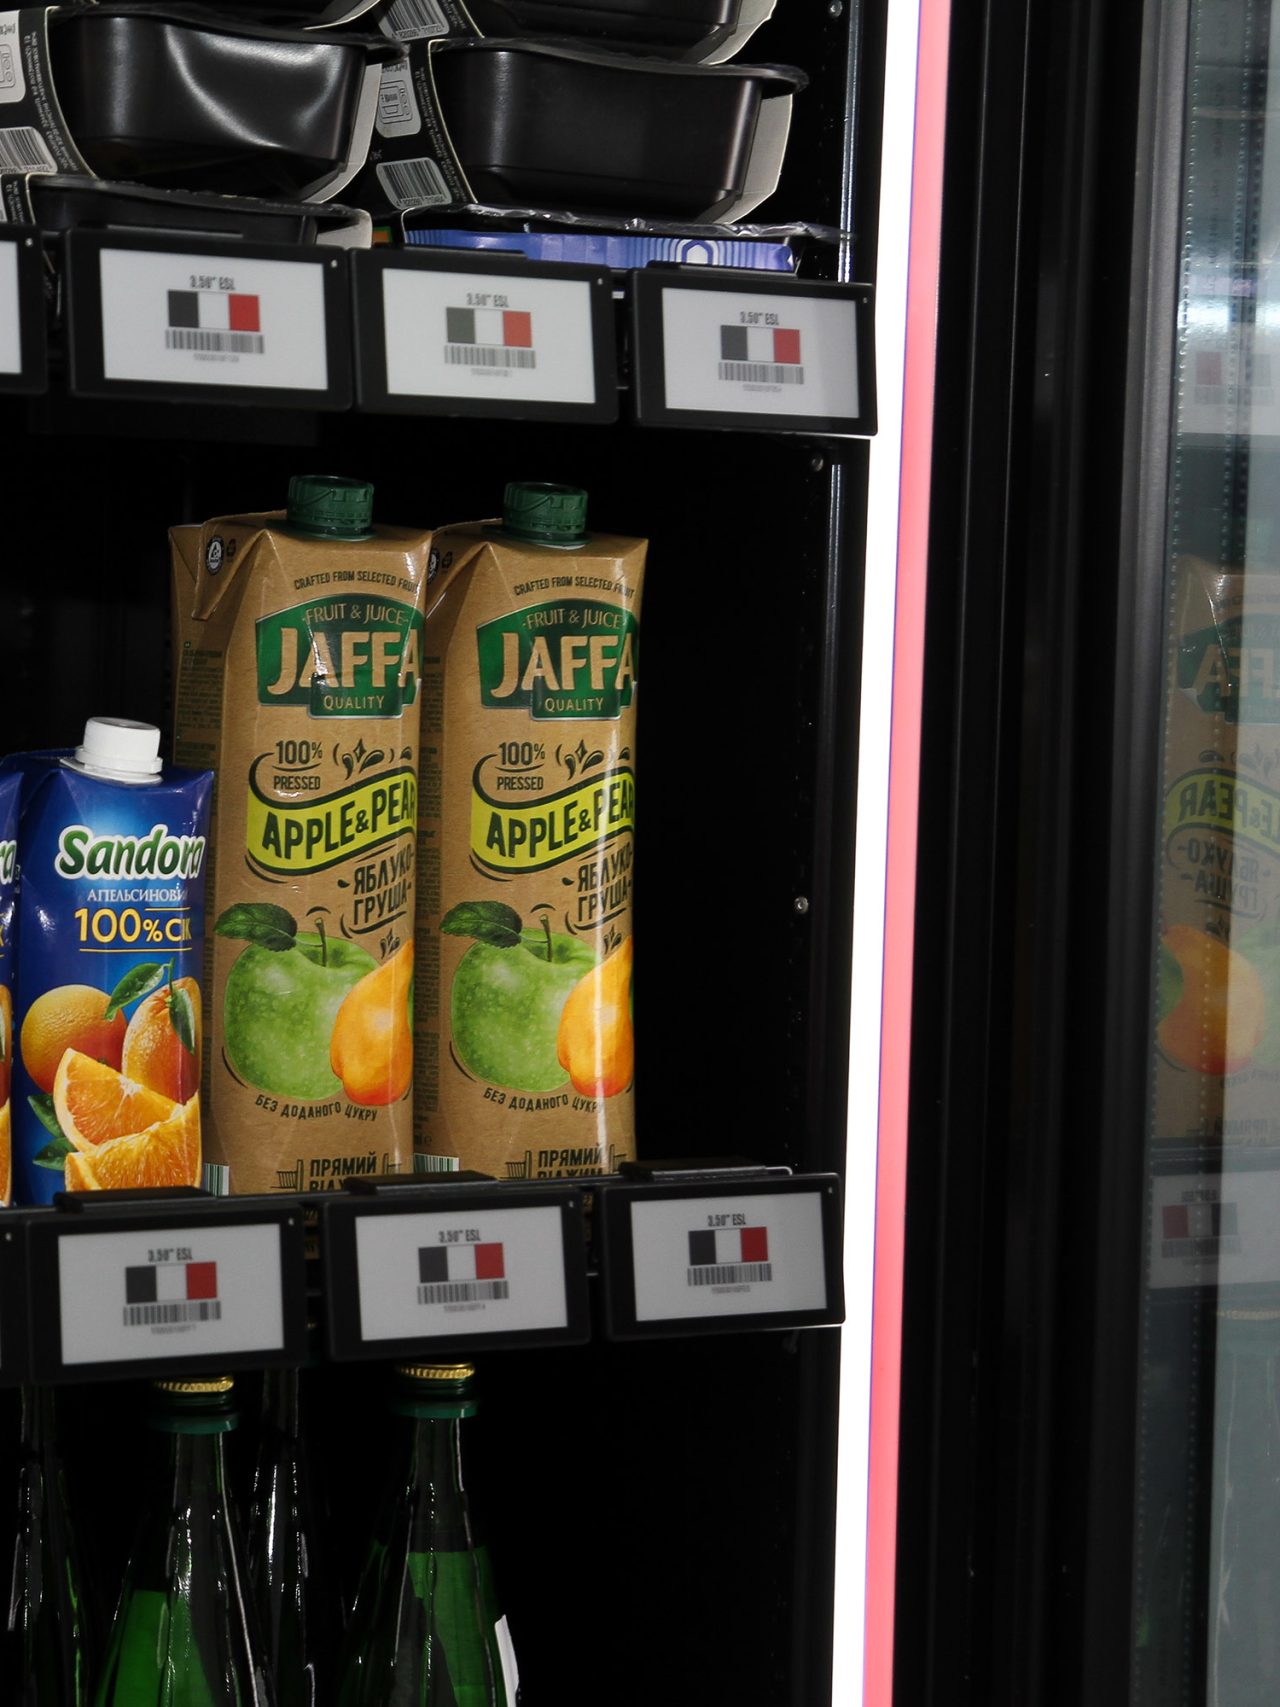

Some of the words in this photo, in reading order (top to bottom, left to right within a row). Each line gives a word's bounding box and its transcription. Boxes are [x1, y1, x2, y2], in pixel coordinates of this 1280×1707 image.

[294, 572, 330, 590] CRAFTED
[332, 570, 355, 582] FROM
[357, 570, 396, 587] SELECTED
[514, 578, 549, 596] CRAFTED
[551, 576, 573, 588] FROM
[575, 576, 613, 591] SELECTED
[350, 604, 361, 619] &
[569, 609, 580, 623] &
[267, 628, 420, 695] JAFFA
[490, 632, 635, 698] JAFFA
[323, 695, 384, 710] QUALITY
[545, 697, 604, 712] QUALITY
[275, 740, 322, 765] 100%
[498, 741, 545, 766] 100%
[273, 775, 321, 790] PRESSED
[497, 776, 544, 790] PRESSED
[54, 824, 206, 880] Sandora
[255, 1094, 279, 1112] БЕЗ
[281, 1101, 341, 1120] ДОДАНОГО
[344, 1104, 377, 1122] ЦУКРУ
[483, 1087, 506, 1105] БЕЗ
[508, 1094, 569, 1113] ДОДАНОГО
[309, 1151, 377, 1177] ПРЯМИЙ
[537, 1143, 603, 1168] ПРЯМИЙ
[732, 1213, 747, 1226] ESL
[465, 1229, 481, 1242] ESL
